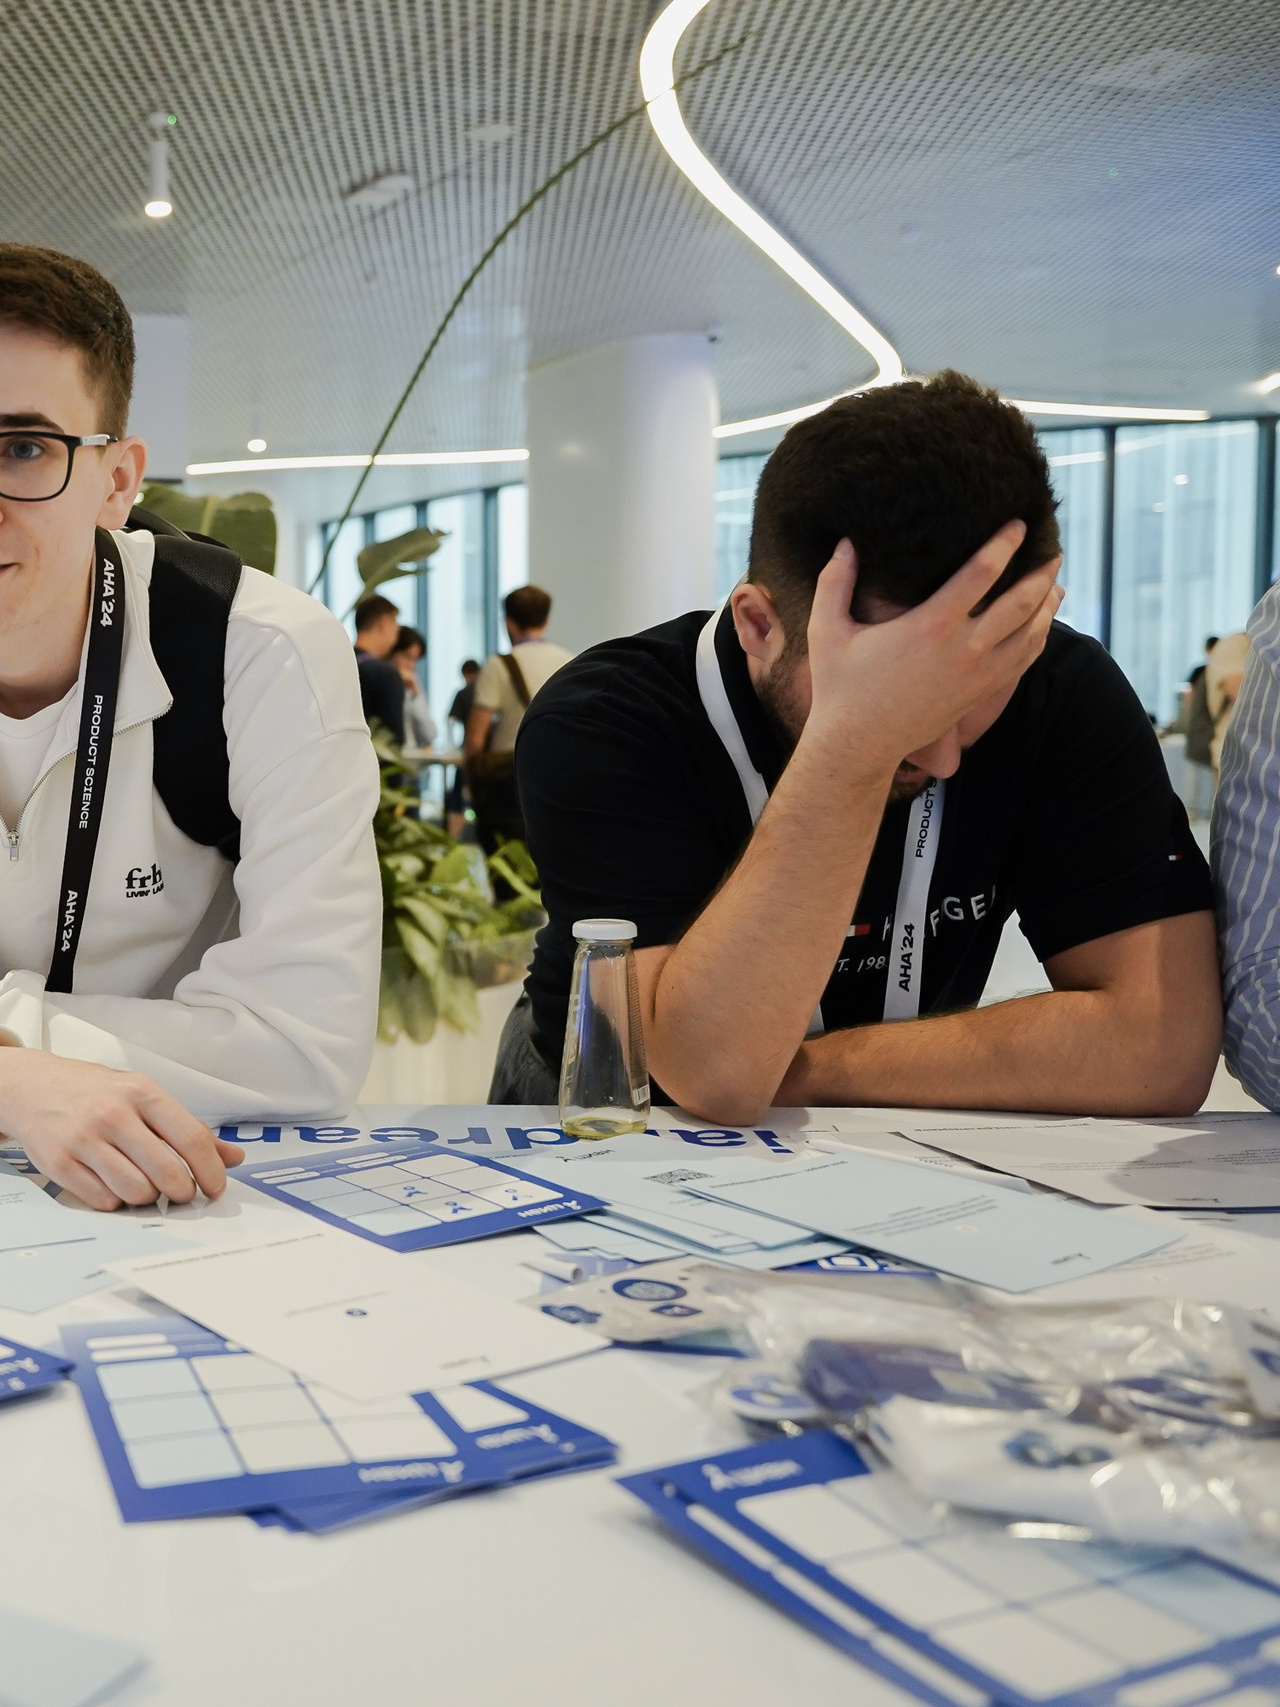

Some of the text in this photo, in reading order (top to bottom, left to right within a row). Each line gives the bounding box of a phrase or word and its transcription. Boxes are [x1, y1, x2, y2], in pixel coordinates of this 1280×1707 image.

[100, 558, 115, 627] AHA'24
[79, 694, 104, 829] PRODUCT SCIENCE
[915, 790, 935, 858] PRODUCT
[61, 889, 78, 952] AHA'24
[838, 955, 888, 973] T. 198
[898, 923, 915, 992] AHA'24
